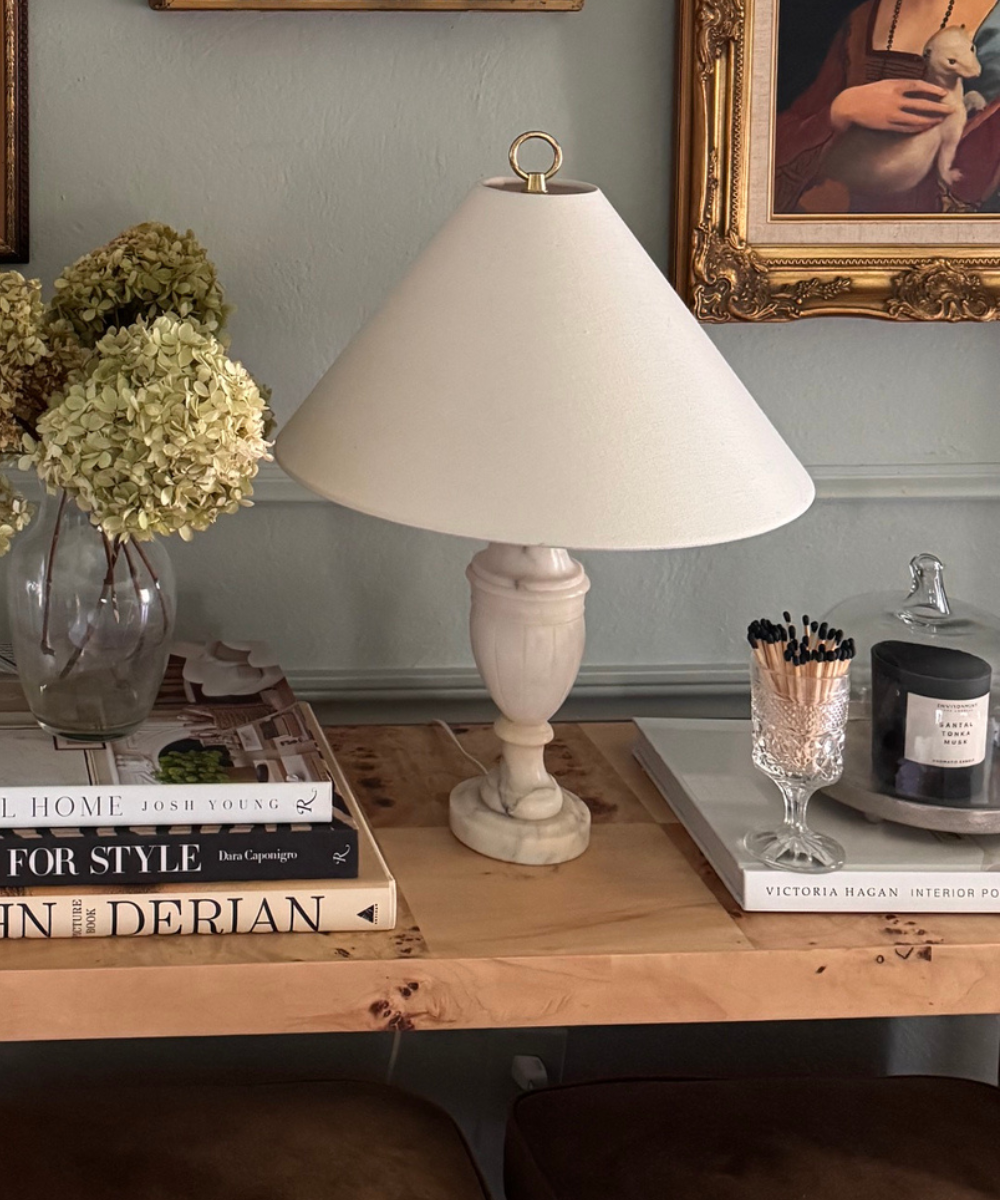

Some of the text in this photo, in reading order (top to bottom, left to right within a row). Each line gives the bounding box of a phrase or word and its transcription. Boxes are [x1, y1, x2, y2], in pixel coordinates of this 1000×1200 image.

[31, 795, 124, 818] HOME
[141, 798, 280, 812] JOSH YOUNG
[7, 847, 79, 877] FOR
[90, 844, 202, 875] STYLE
[218, 849, 298, 864] Dara Caponigro
[766, 886, 899, 897] VICTORIA HAGAN
[910, 888, 975, 898] INTERIOR
[85, 908, 96, 935] BOOK
[107, 895, 326, 937] DERIAN
